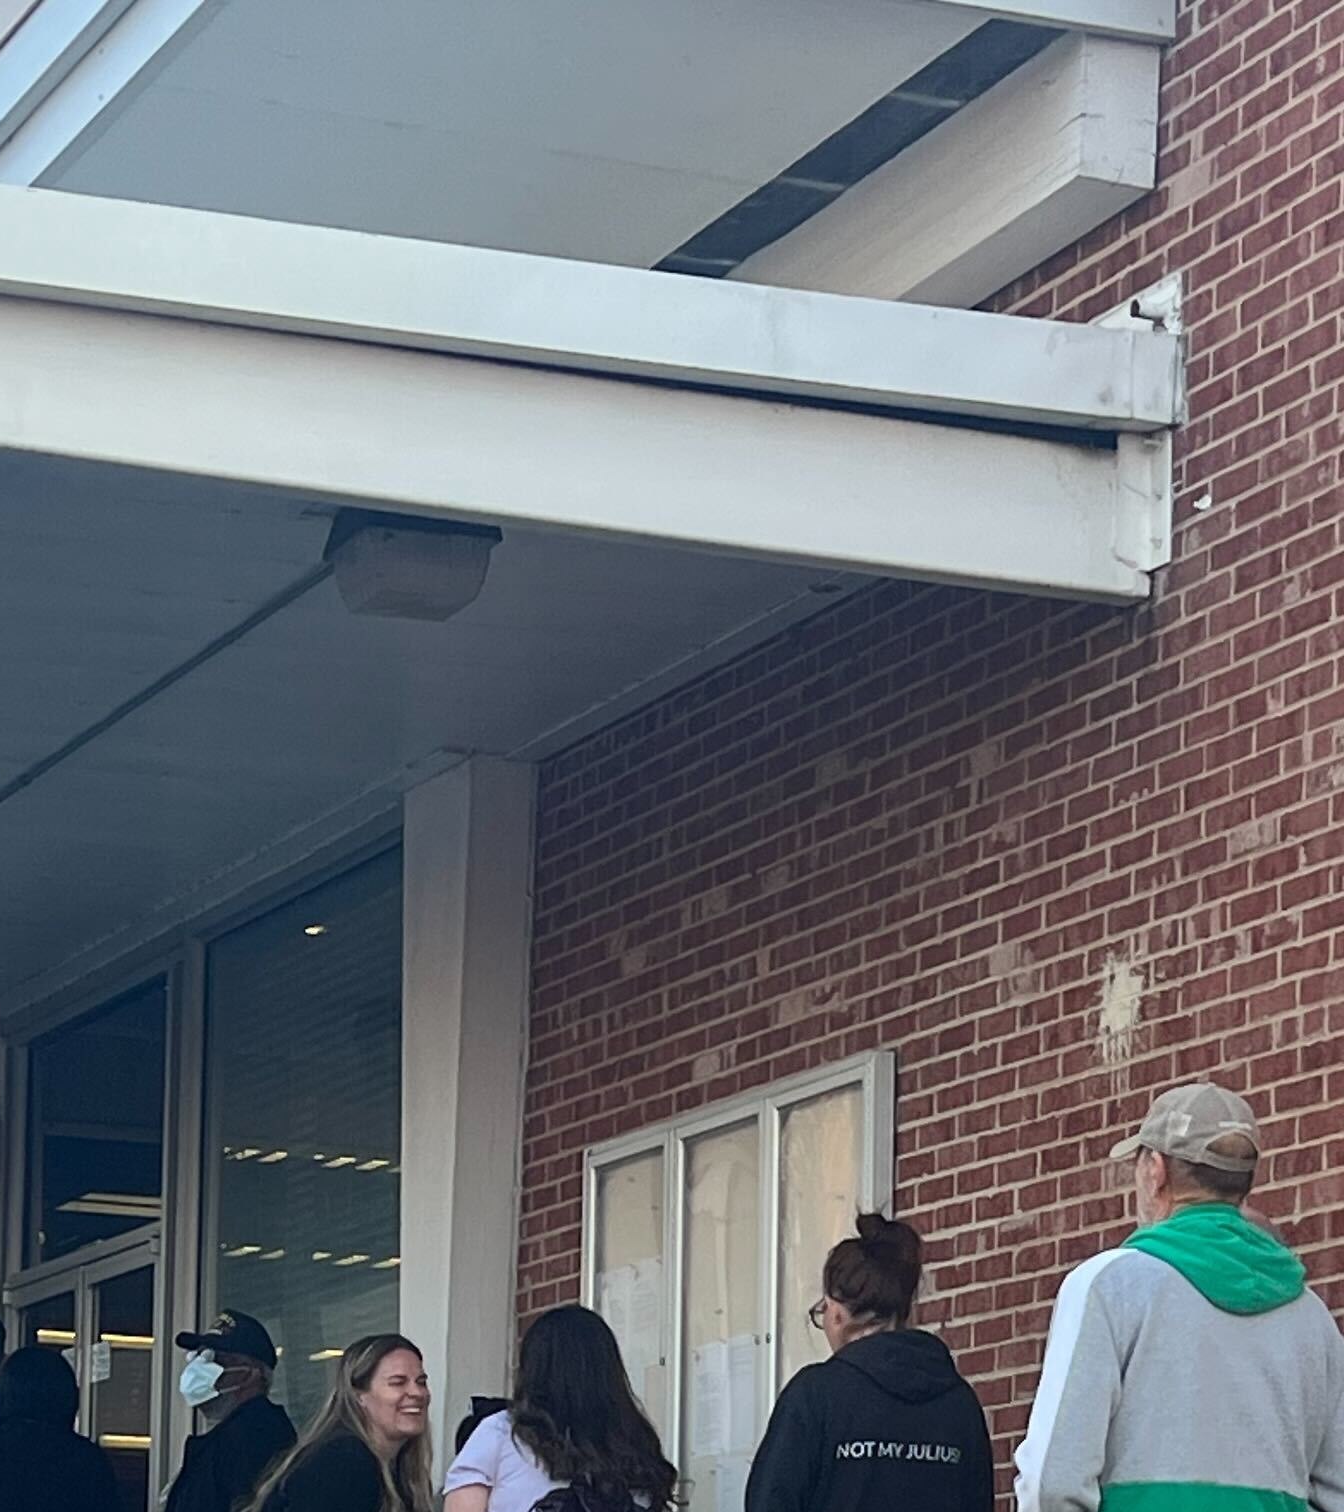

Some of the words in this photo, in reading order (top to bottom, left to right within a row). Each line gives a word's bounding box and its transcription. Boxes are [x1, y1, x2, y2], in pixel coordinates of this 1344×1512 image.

[836, 1441, 876, 1460] NOT
[877, 1443, 904, 1458] MY
[905, 1444, 961, 1464] JULIUS
